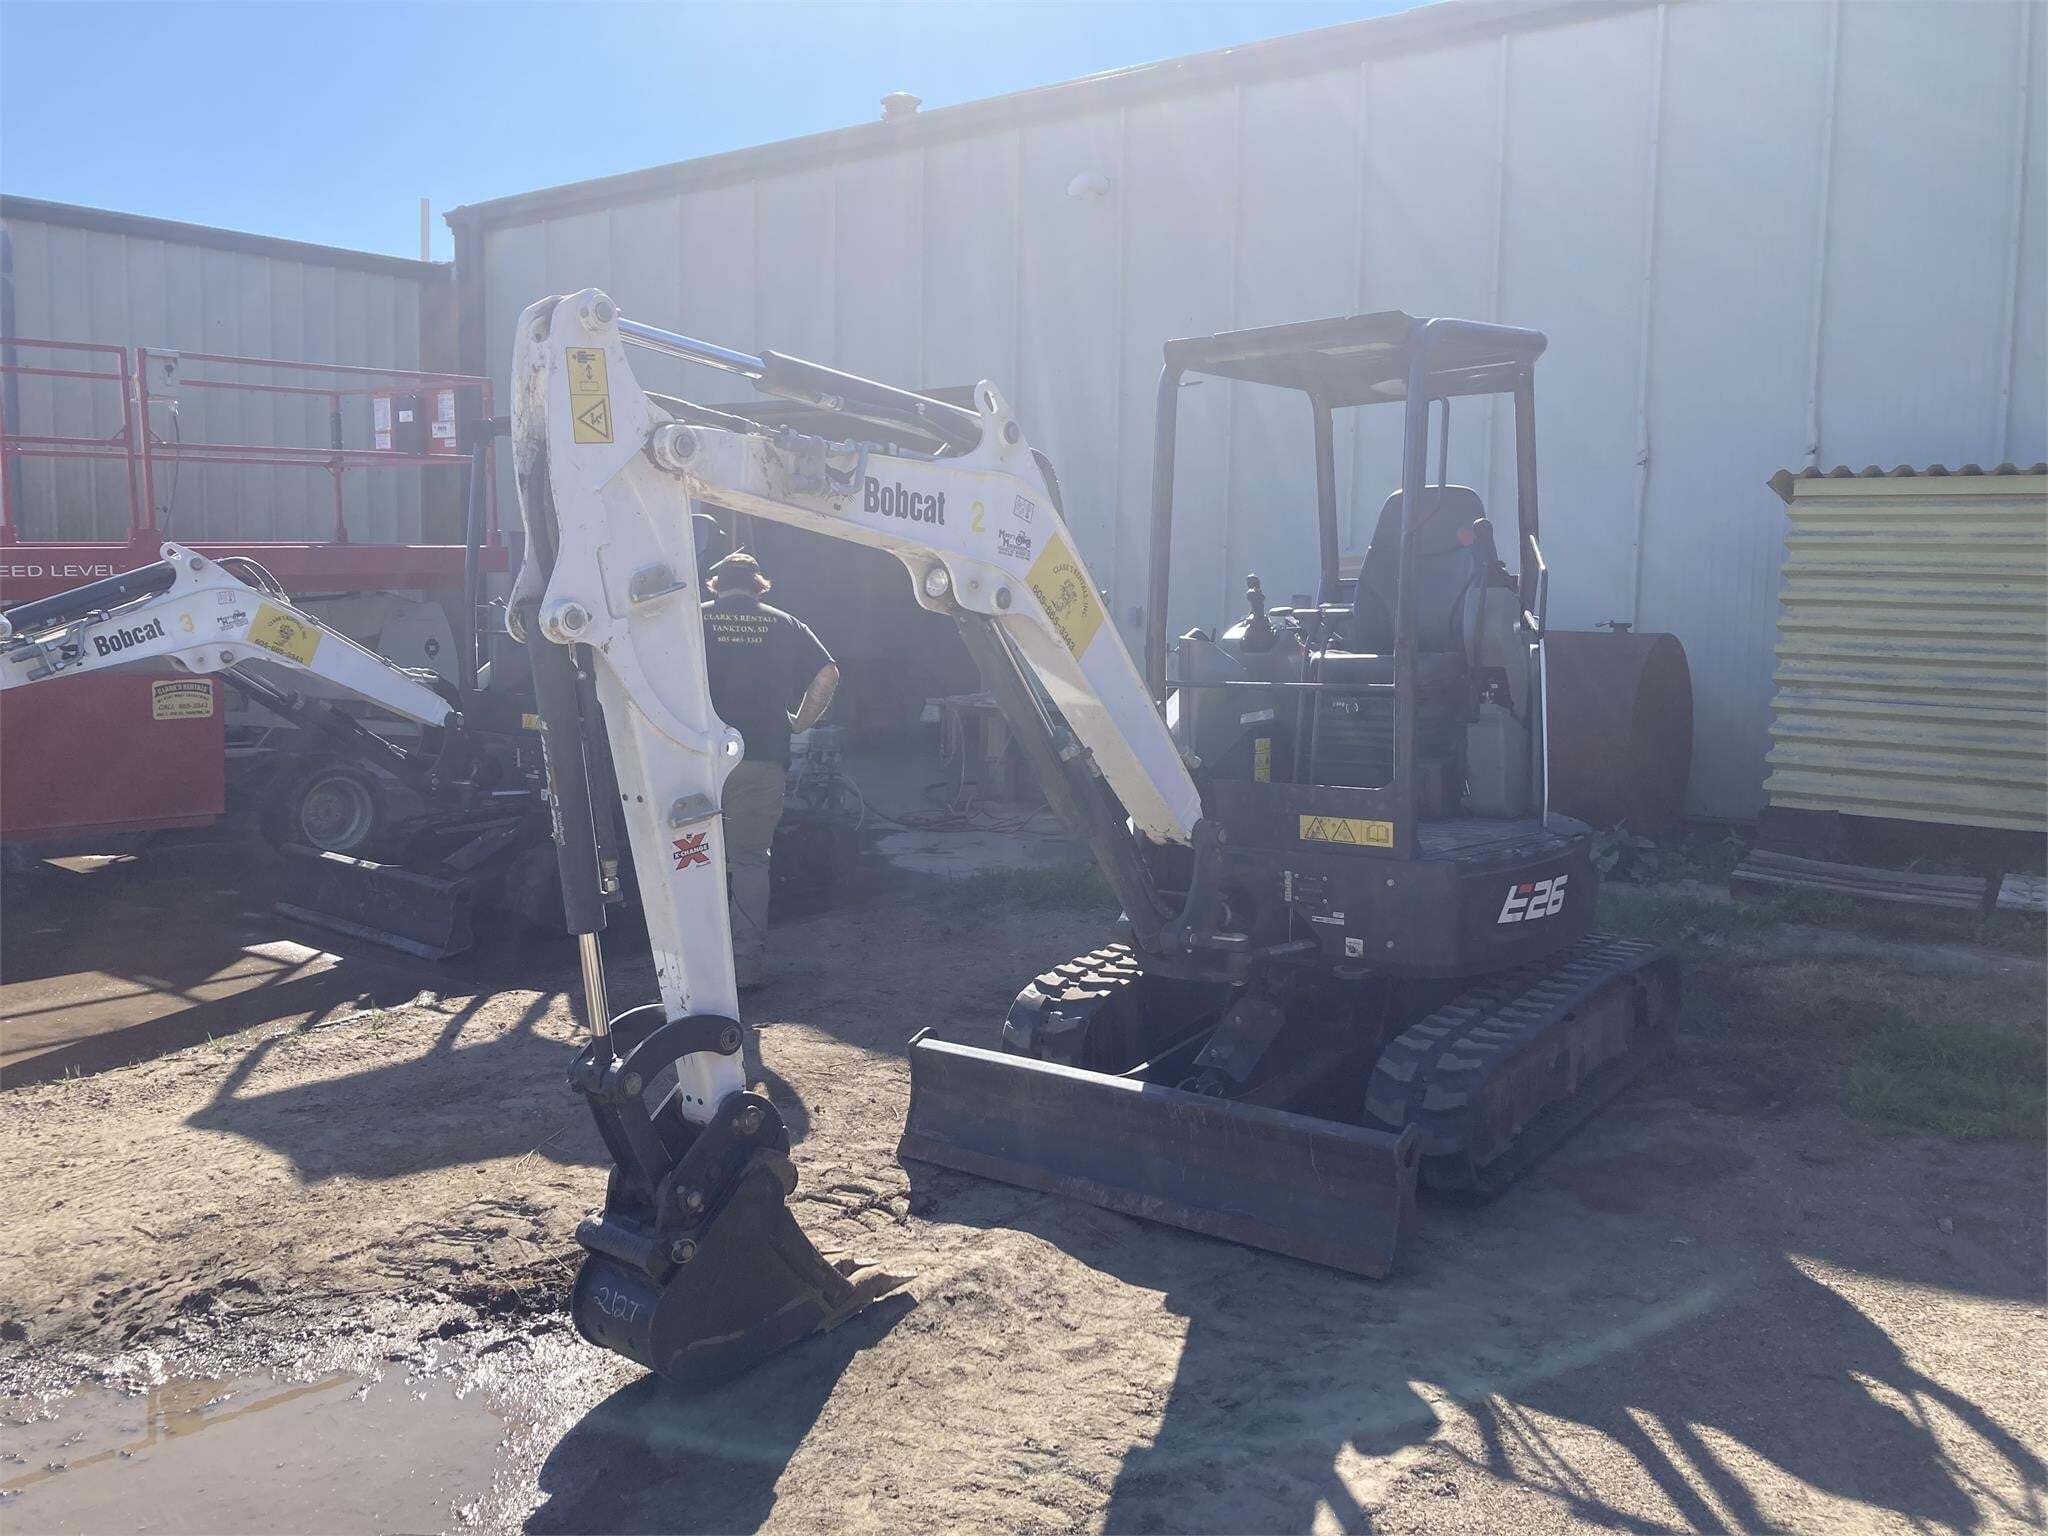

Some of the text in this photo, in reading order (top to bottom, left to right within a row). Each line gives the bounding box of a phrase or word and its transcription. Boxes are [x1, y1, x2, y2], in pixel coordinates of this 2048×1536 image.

[864, 476, 985, 533] Bobcat 2
[51, 565, 119, 577] LEVEL
[93, 617, 166, 656] Bobcat
[179, 612, 195, 633] 3
[1497, 875, 1568, 923] E26
